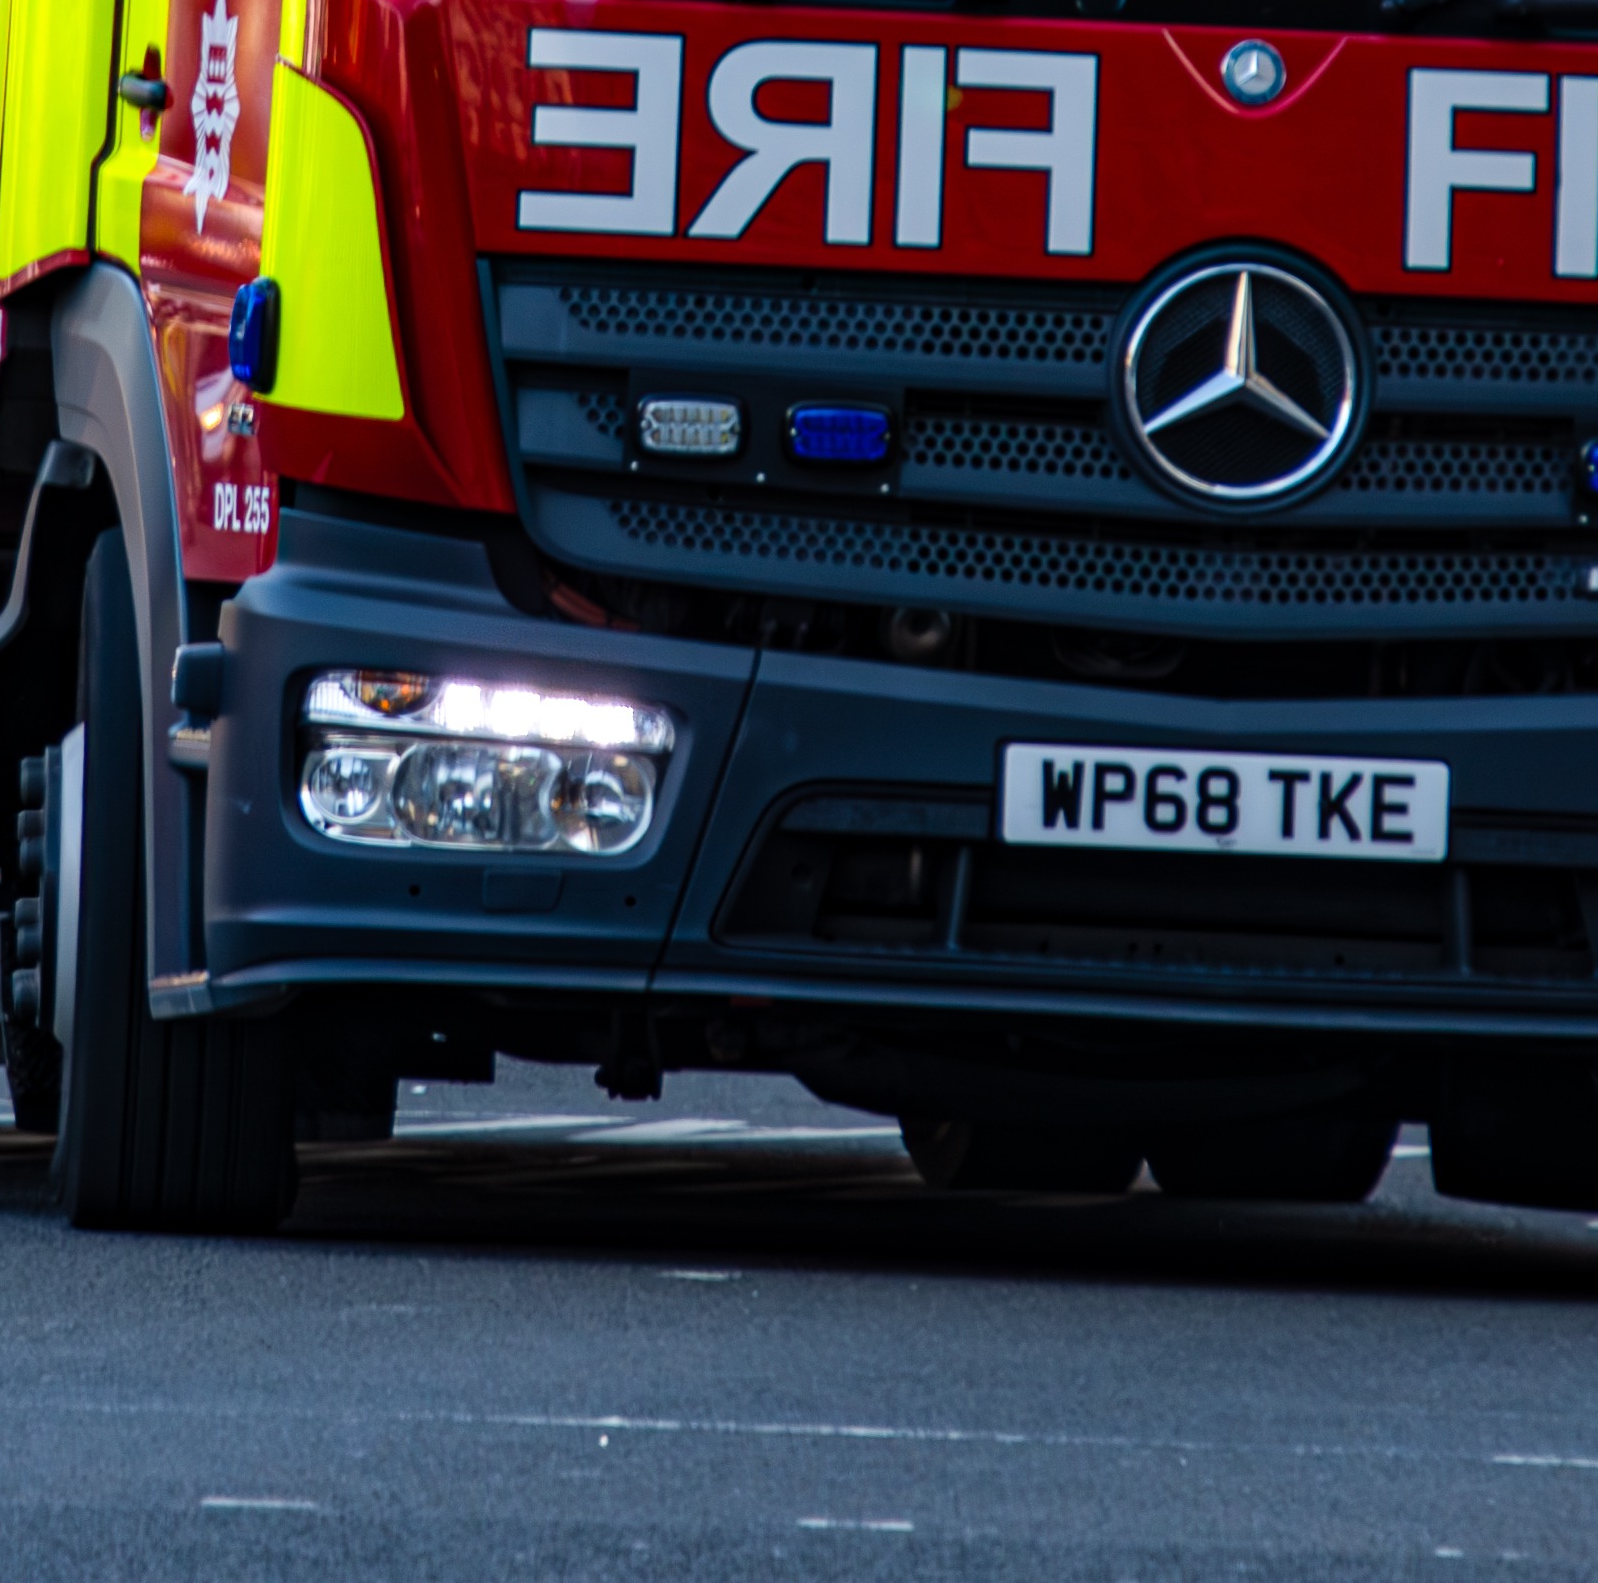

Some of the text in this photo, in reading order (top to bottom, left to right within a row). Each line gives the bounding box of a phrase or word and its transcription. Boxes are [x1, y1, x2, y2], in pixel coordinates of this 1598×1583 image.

[214, 481, 270, 535] DPL 255
[1042, 759, 1416, 844] WP68 TKE
